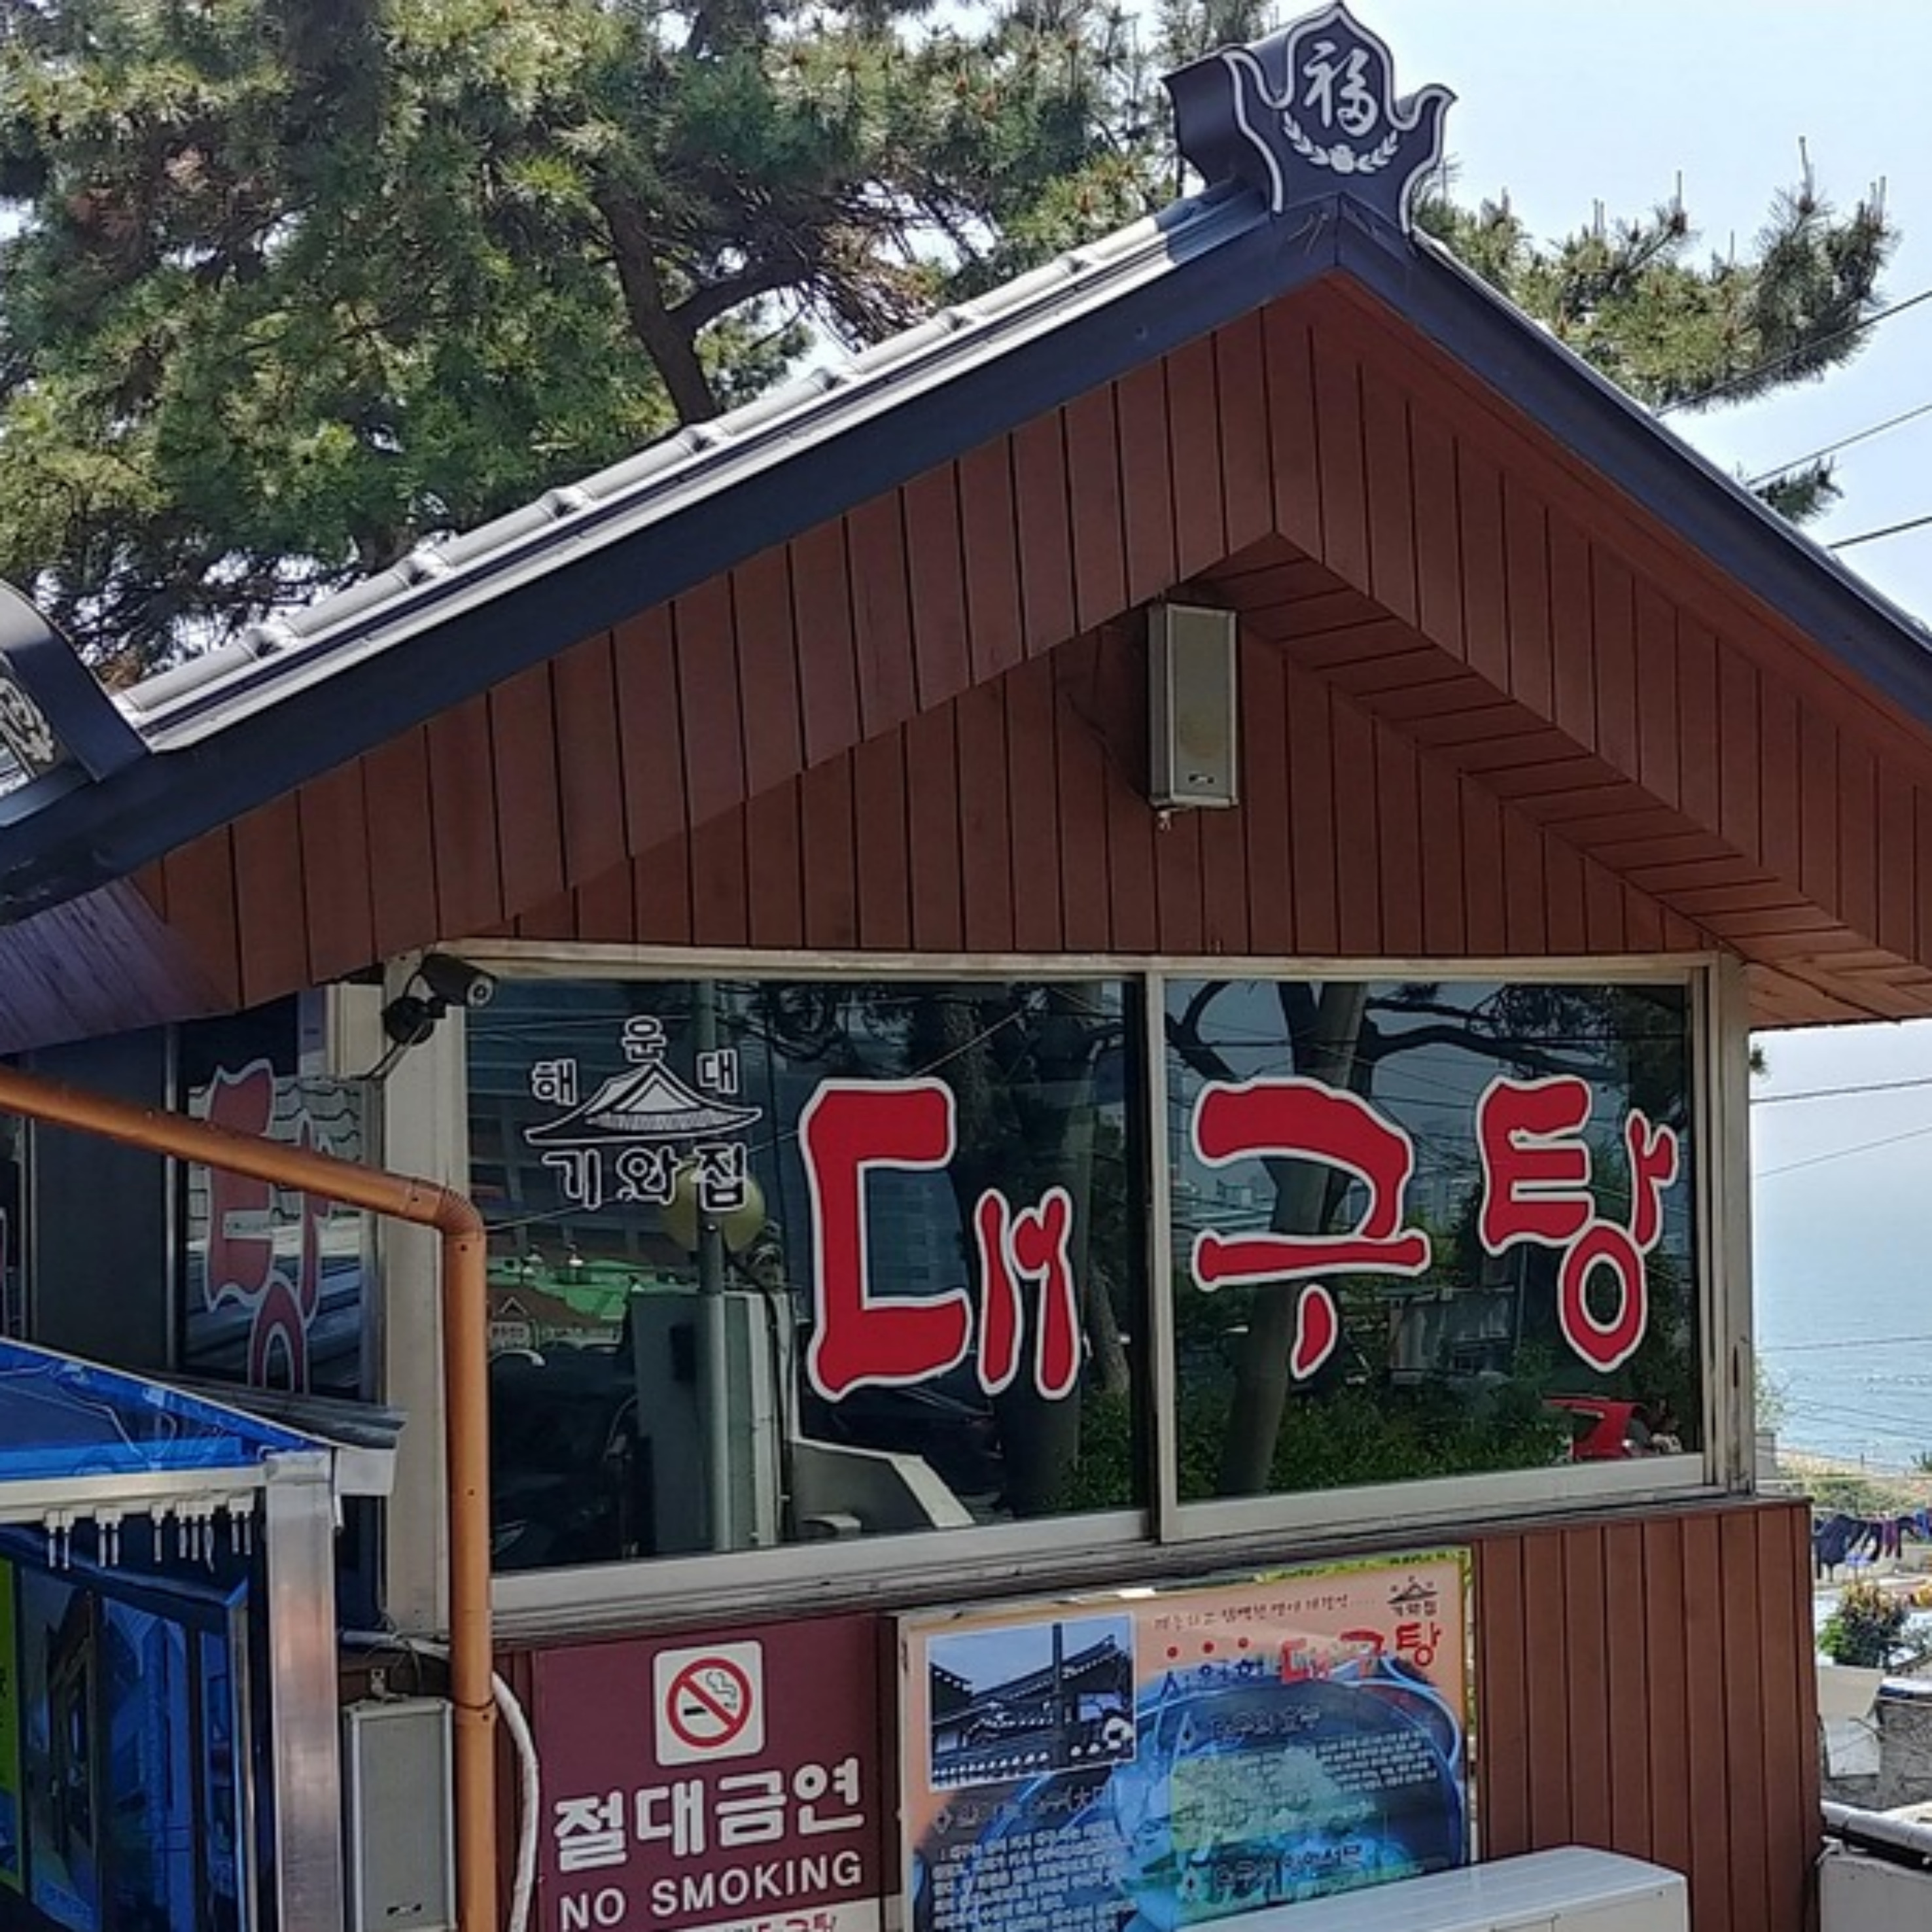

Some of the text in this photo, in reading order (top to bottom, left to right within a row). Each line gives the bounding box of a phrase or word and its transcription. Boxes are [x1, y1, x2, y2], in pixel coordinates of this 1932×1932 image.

[1303, 41, 1379, 136] 福
[531, 1014, 740, 1106] 해운대
[541, 1140, 747, 1212] 기와집
[799, 1076, 1678, 1403] 대구탕
[554, 1757, 865, 1872] 절대금연
[559, 1851, 863, 1932] NO SMOKING
